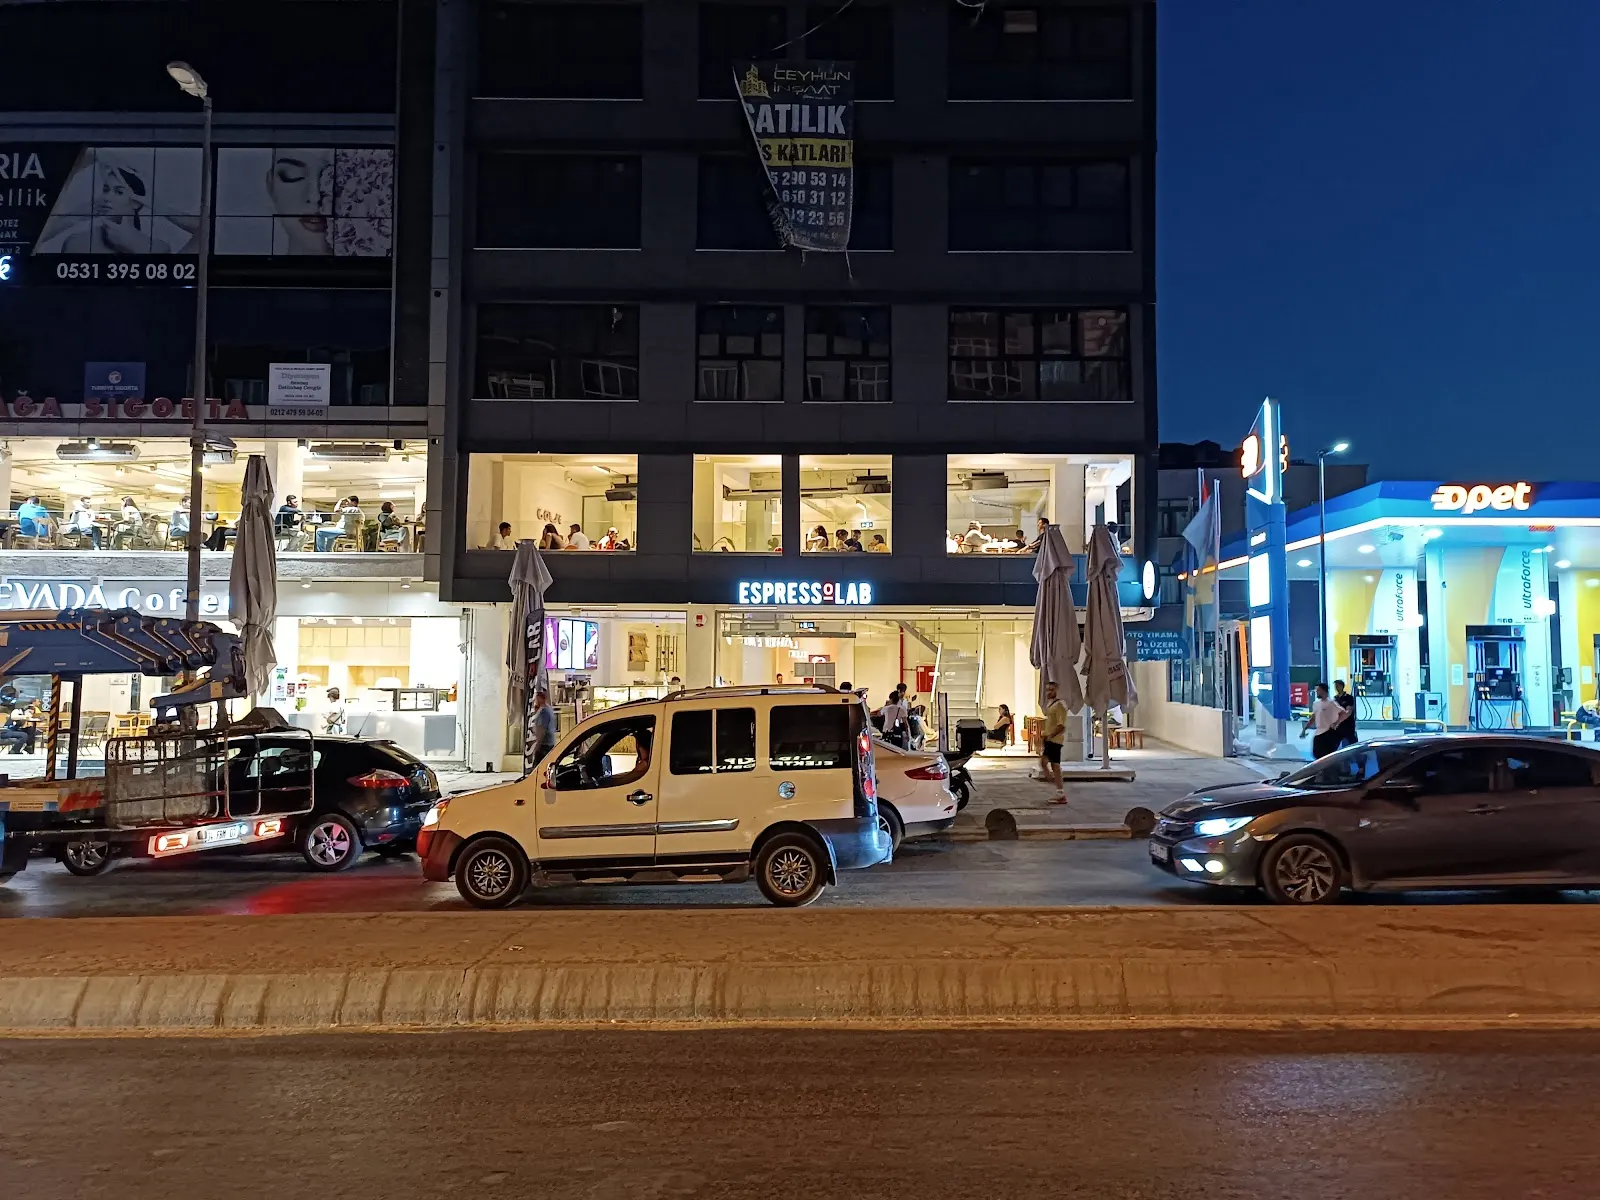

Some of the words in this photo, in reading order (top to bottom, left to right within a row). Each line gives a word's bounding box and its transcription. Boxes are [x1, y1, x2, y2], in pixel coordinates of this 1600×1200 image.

[774, 69, 851, 81] CEYHUN
[777, 144, 846, 163] KATLARI
[810, 171, 827, 187] 53
[831, 172, 847, 187] 14
[810, 190, 825, 206] 31
[830, 191, 846, 206] 12
[807, 211, 825, 226] 23
[56, 262, 99, 279] 0531
[107, 263, 140, 280] 395
[146, 263, 168, 280] 08
[173, 263, 196, 280] 02
[270, 408, 285, 416] 0212
[1521, 550, 1532, 609] ultraforce
[739, 581, 872, 605] ESPRESSOLAB
[1395, 572, 1404, 622] ultraforce
